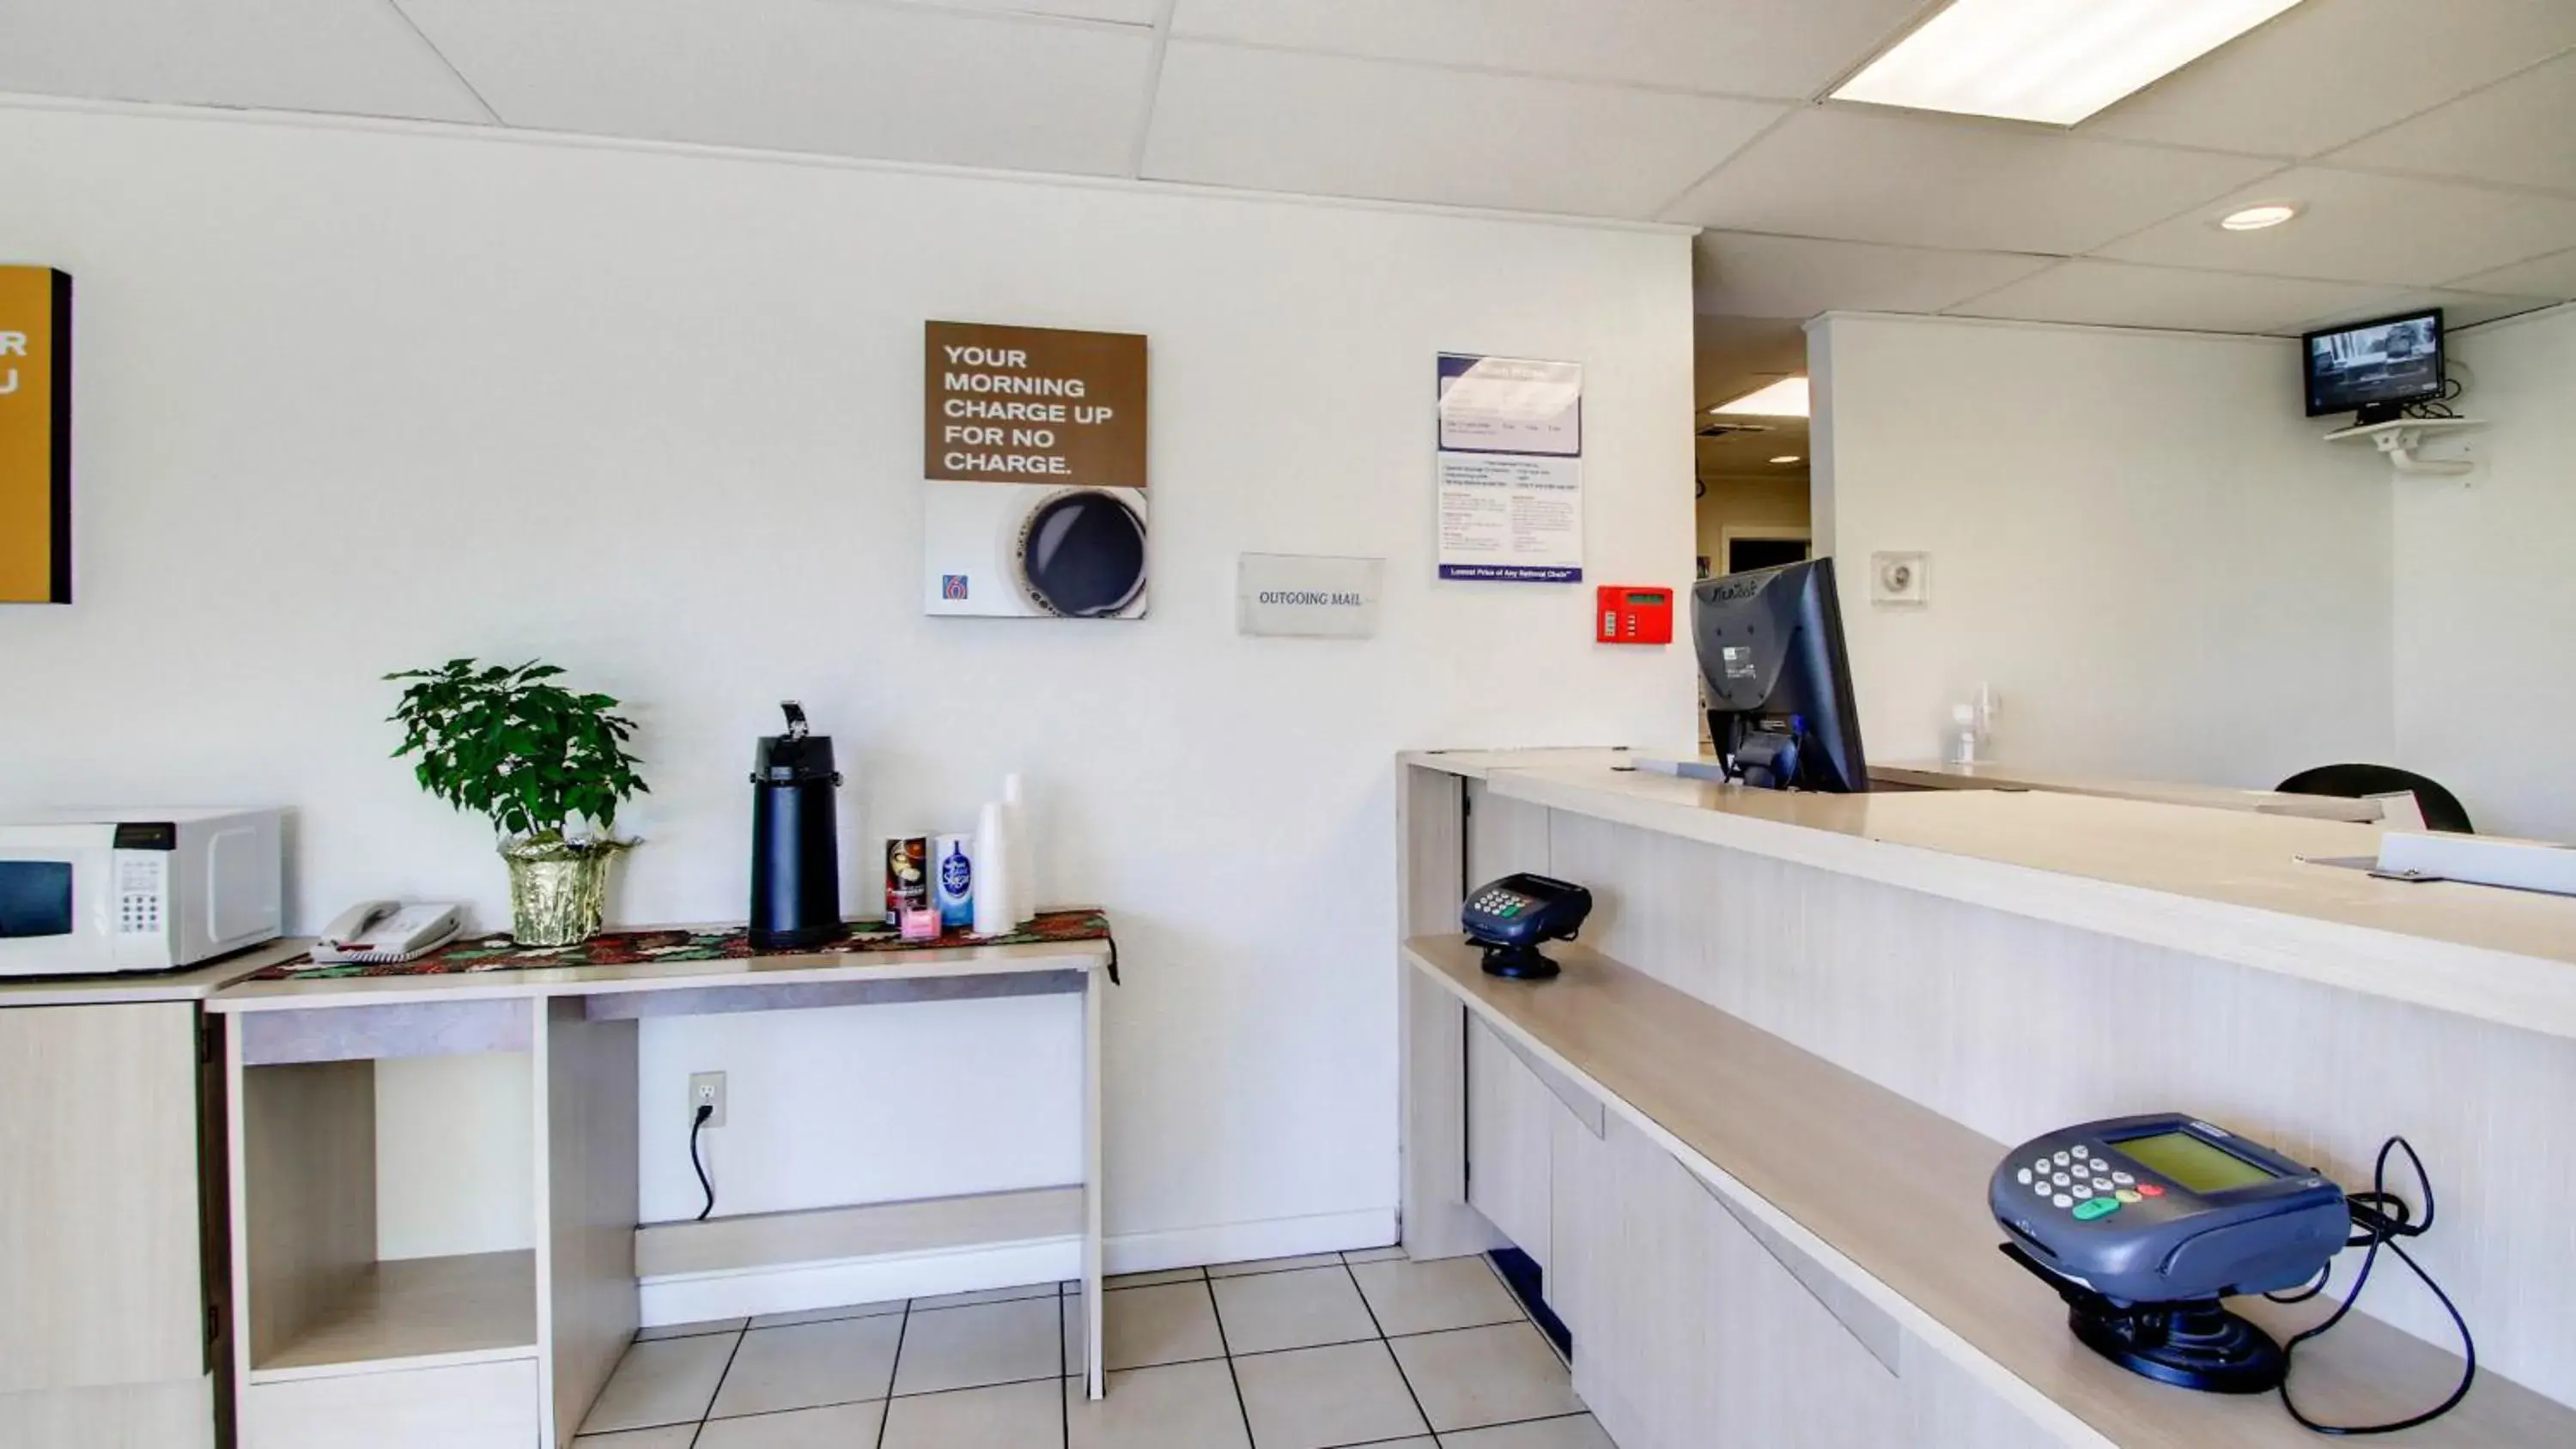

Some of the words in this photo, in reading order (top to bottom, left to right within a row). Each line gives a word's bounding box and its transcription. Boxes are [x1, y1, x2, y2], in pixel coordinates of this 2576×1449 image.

[944, 345, 1026, 368] YOUR
[945, 372, 1085, 397] MORNING
[945, 399, 1066, 422] CHARGE
[1074, 405, 1113, 424] UP
[945, 426, 1003, 446] FOR
[1012, 429, 1054, 447] NO
[944, 452, 1072, 475] CHARGE.
[1259, 591, 1327, 605] OUTGOING
[1331, 593, 1361, 606] MAIL
